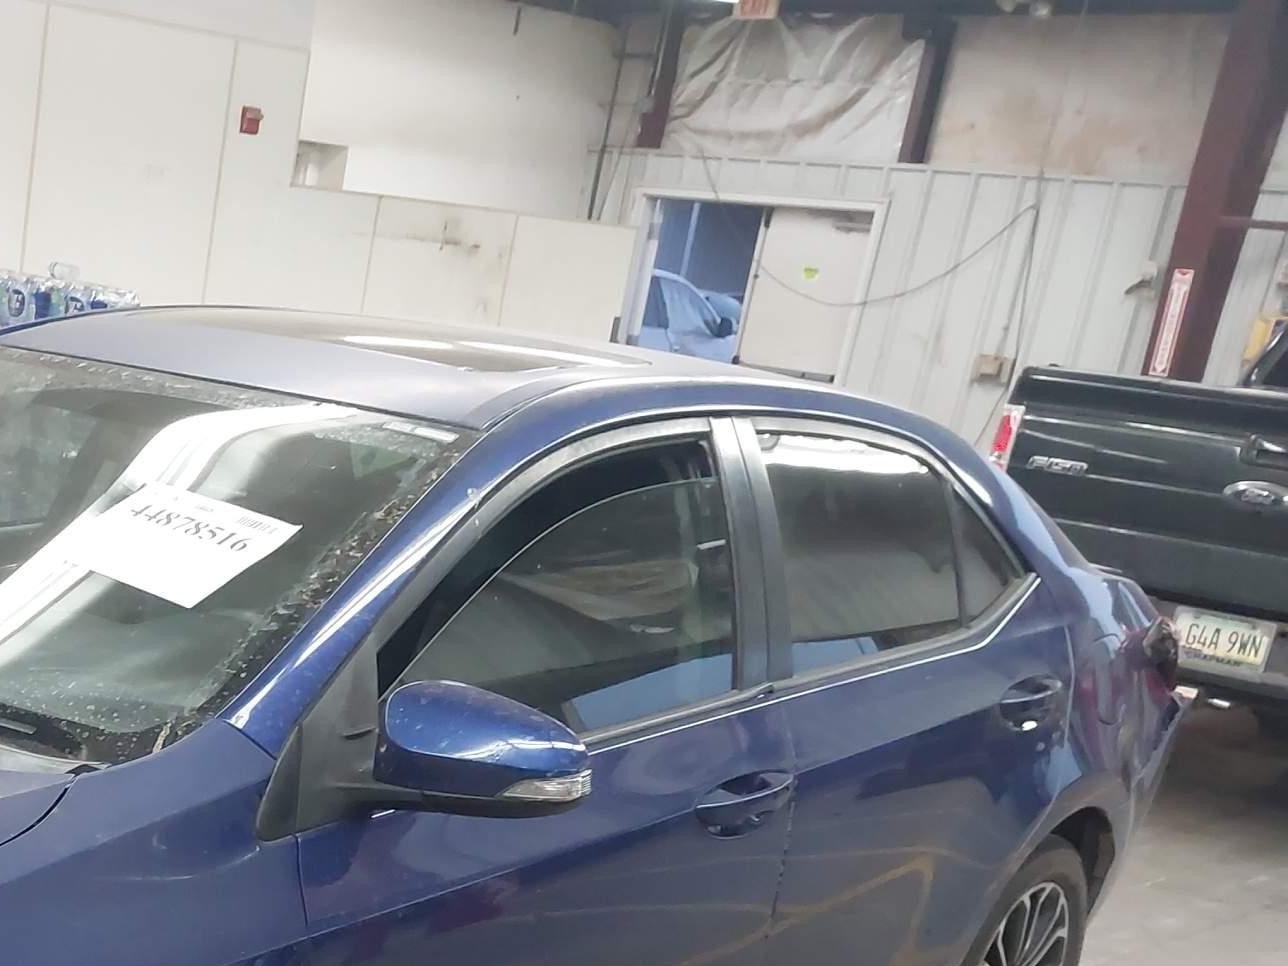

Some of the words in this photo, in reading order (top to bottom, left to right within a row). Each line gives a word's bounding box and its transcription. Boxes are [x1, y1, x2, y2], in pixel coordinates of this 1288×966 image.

[131, 505, 251, 551] 44878516
[1185, 623, 1221, 651] G4A
[1227, 631, 1262, 657] 9WN
